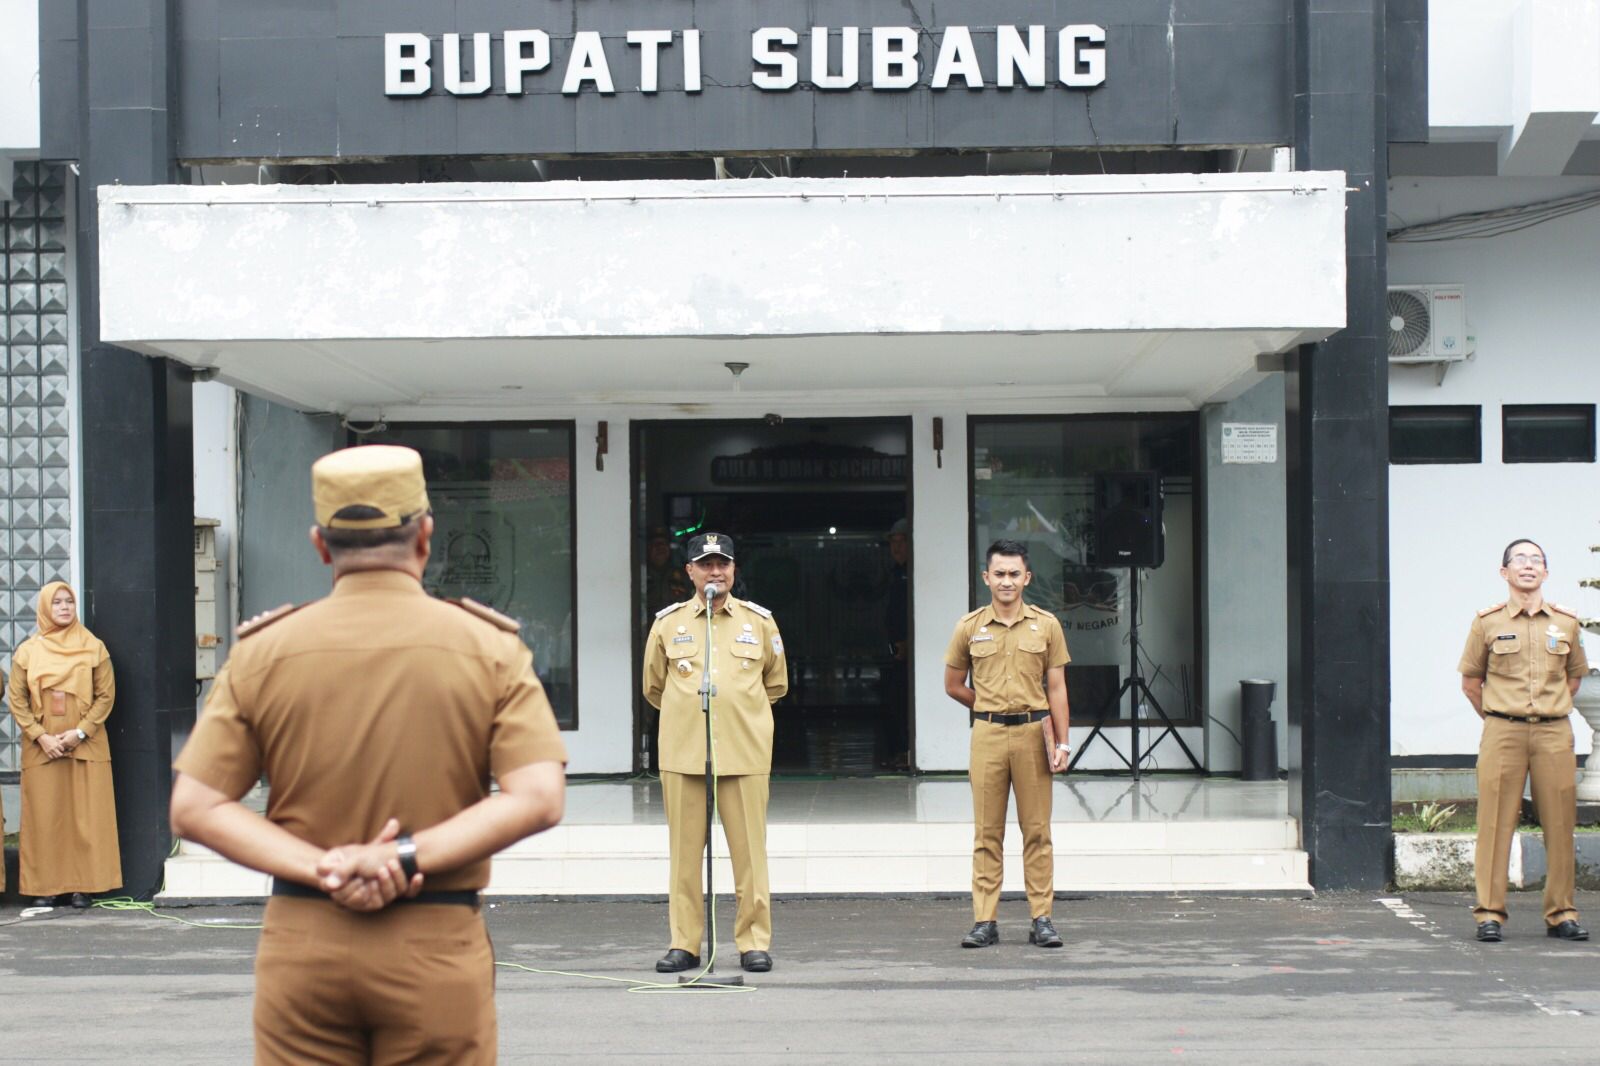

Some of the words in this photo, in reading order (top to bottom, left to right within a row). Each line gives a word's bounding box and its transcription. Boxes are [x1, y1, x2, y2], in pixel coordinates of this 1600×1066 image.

[384, 29, 702, 96] BUPATI
[752, 24, 1107, 92] SUBANG
[717, 459, 757, 478] AULA
